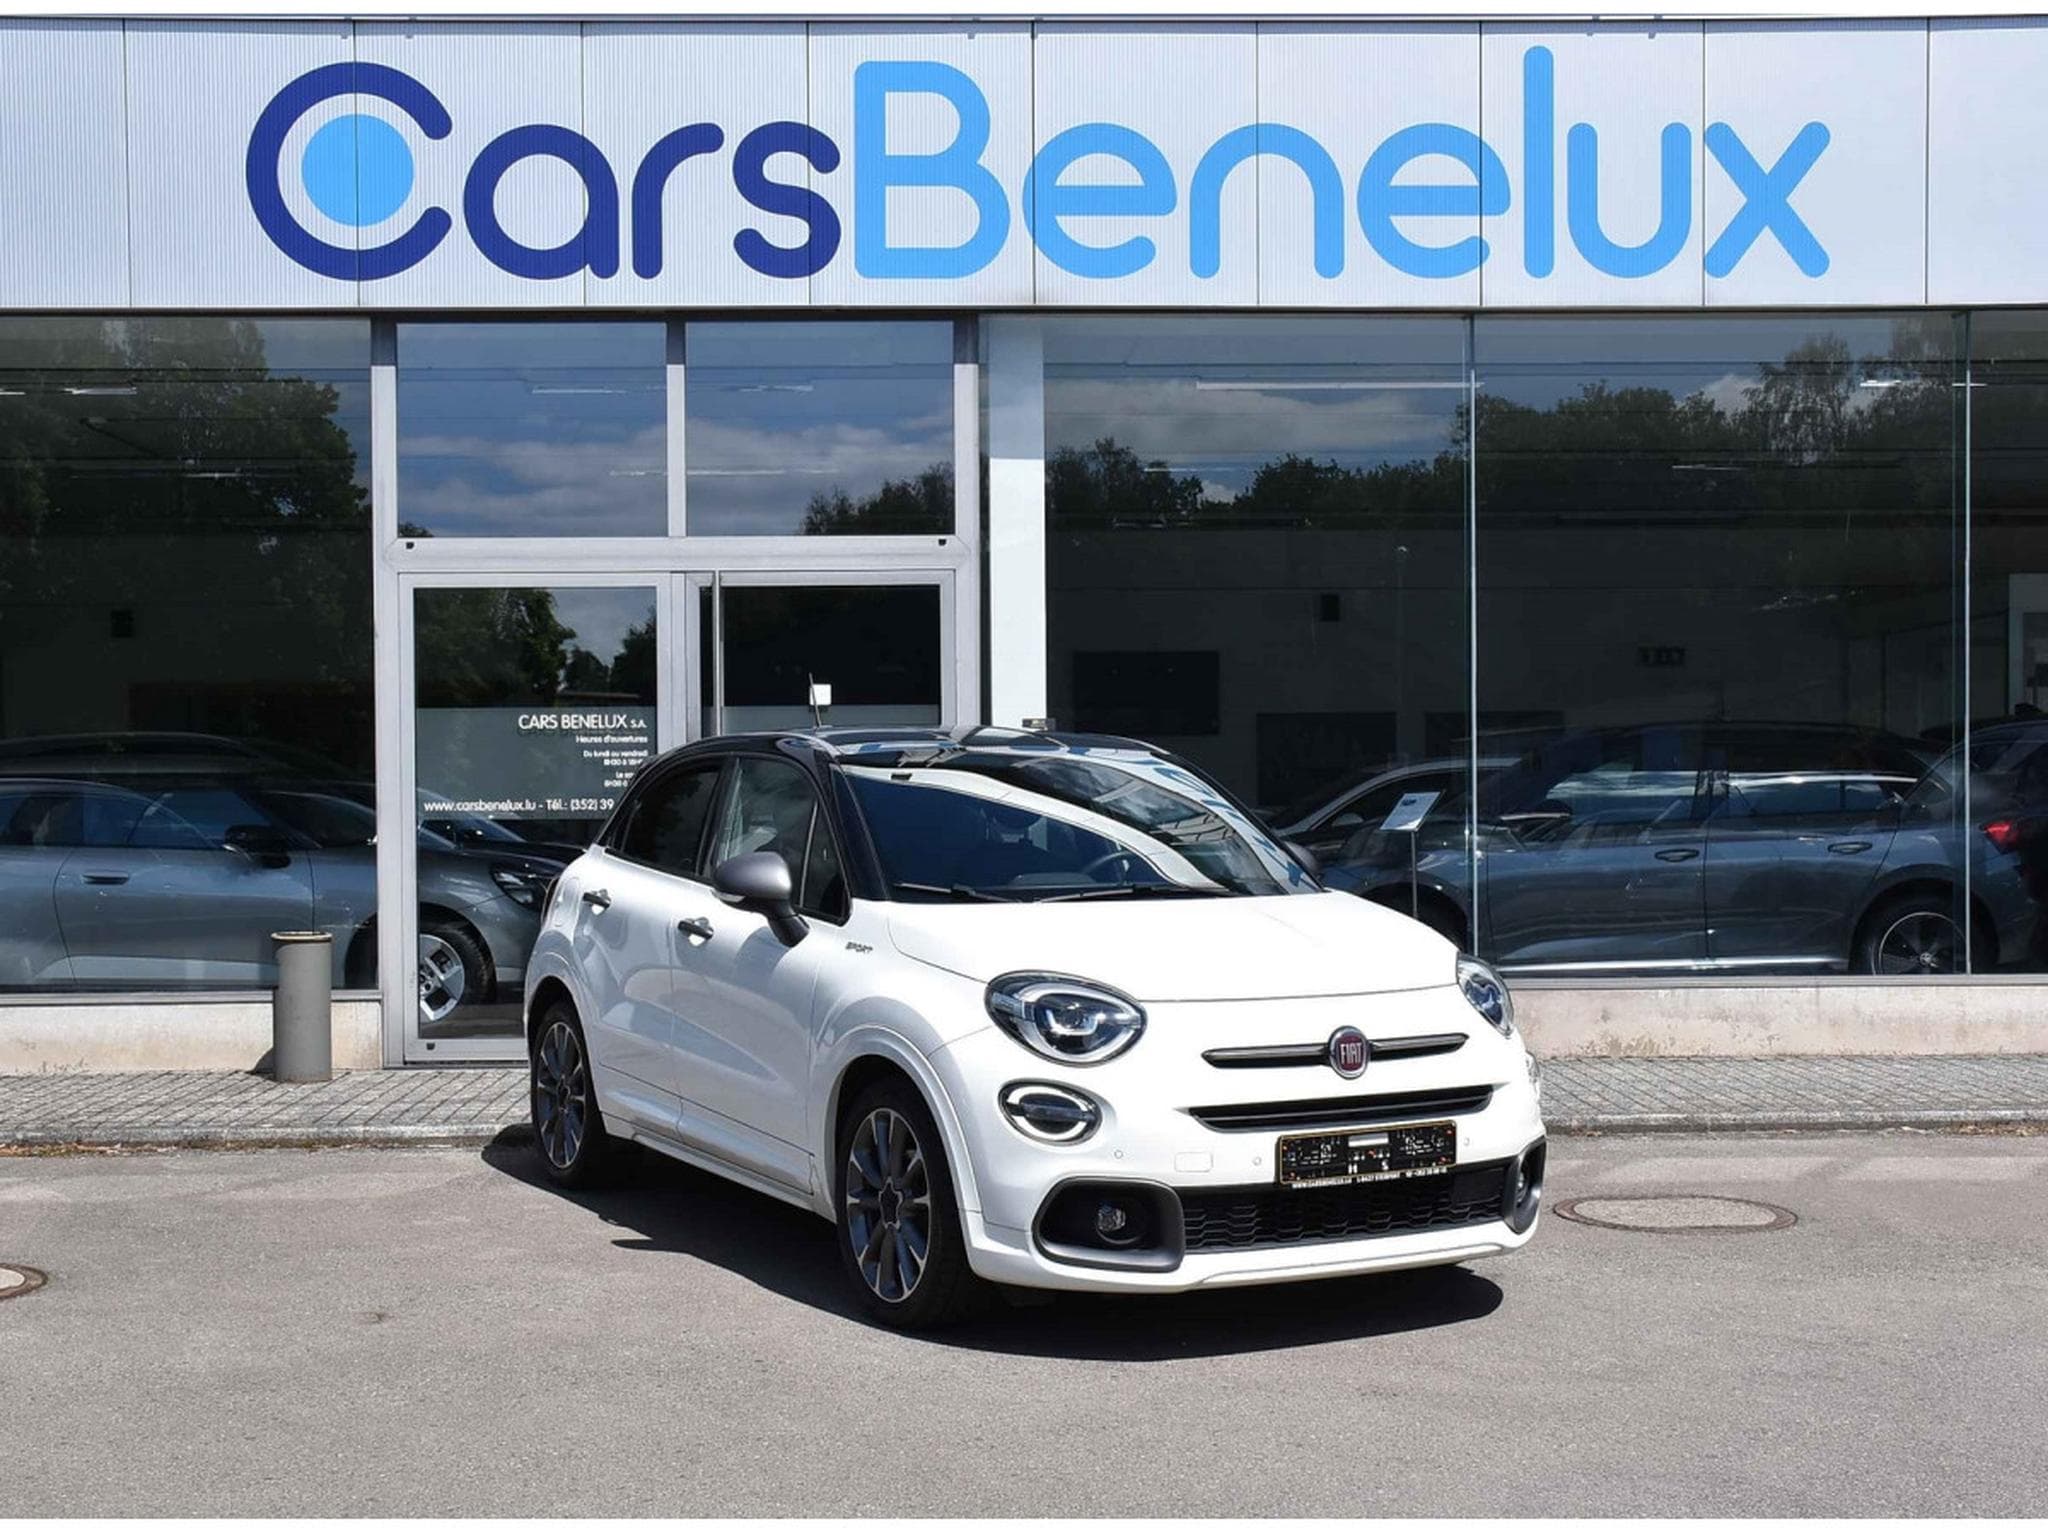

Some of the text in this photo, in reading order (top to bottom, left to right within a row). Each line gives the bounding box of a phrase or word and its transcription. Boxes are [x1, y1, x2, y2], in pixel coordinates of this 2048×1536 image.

[518, 715, 558, 729] CARS
[561, 715, 628, 729] BENELUX
[576, 735, 603, 744] Heures
[423, 799, 537, 812] www.carsbenelux.lu
[570, 798, 598, 812] (352)
[599, 798, 615, 811] 39
[1340, 1042, 1362, 1065] FIAT
